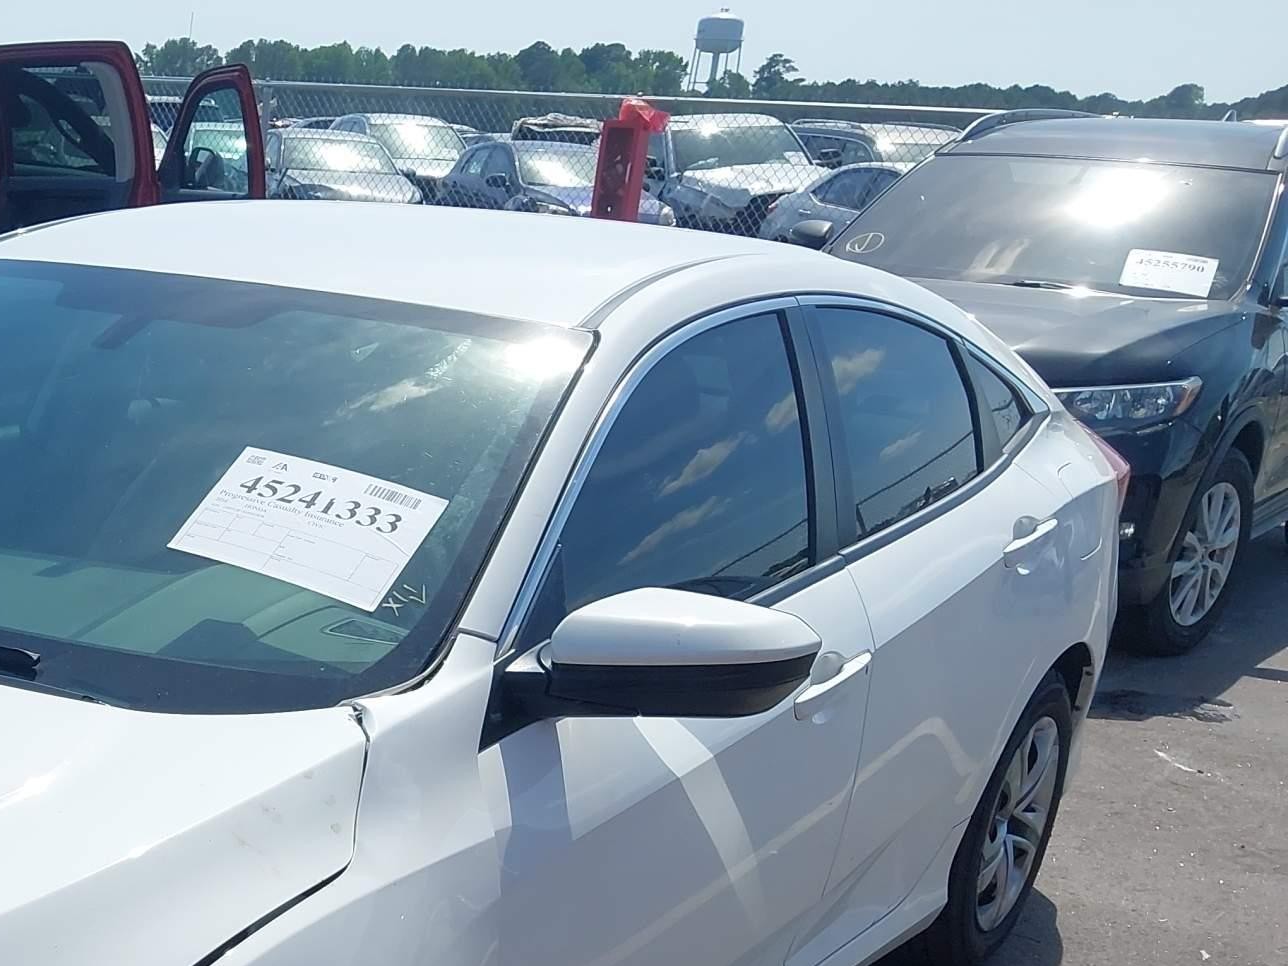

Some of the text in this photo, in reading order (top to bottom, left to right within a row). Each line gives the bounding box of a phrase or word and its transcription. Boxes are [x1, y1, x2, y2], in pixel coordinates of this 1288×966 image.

[220, 488, 266, 506] Progressive
[267, 499, 304, 516] Casualty
[304, 510, 345, 528] Insurance
[239, 475, 403, 534] 45241333
